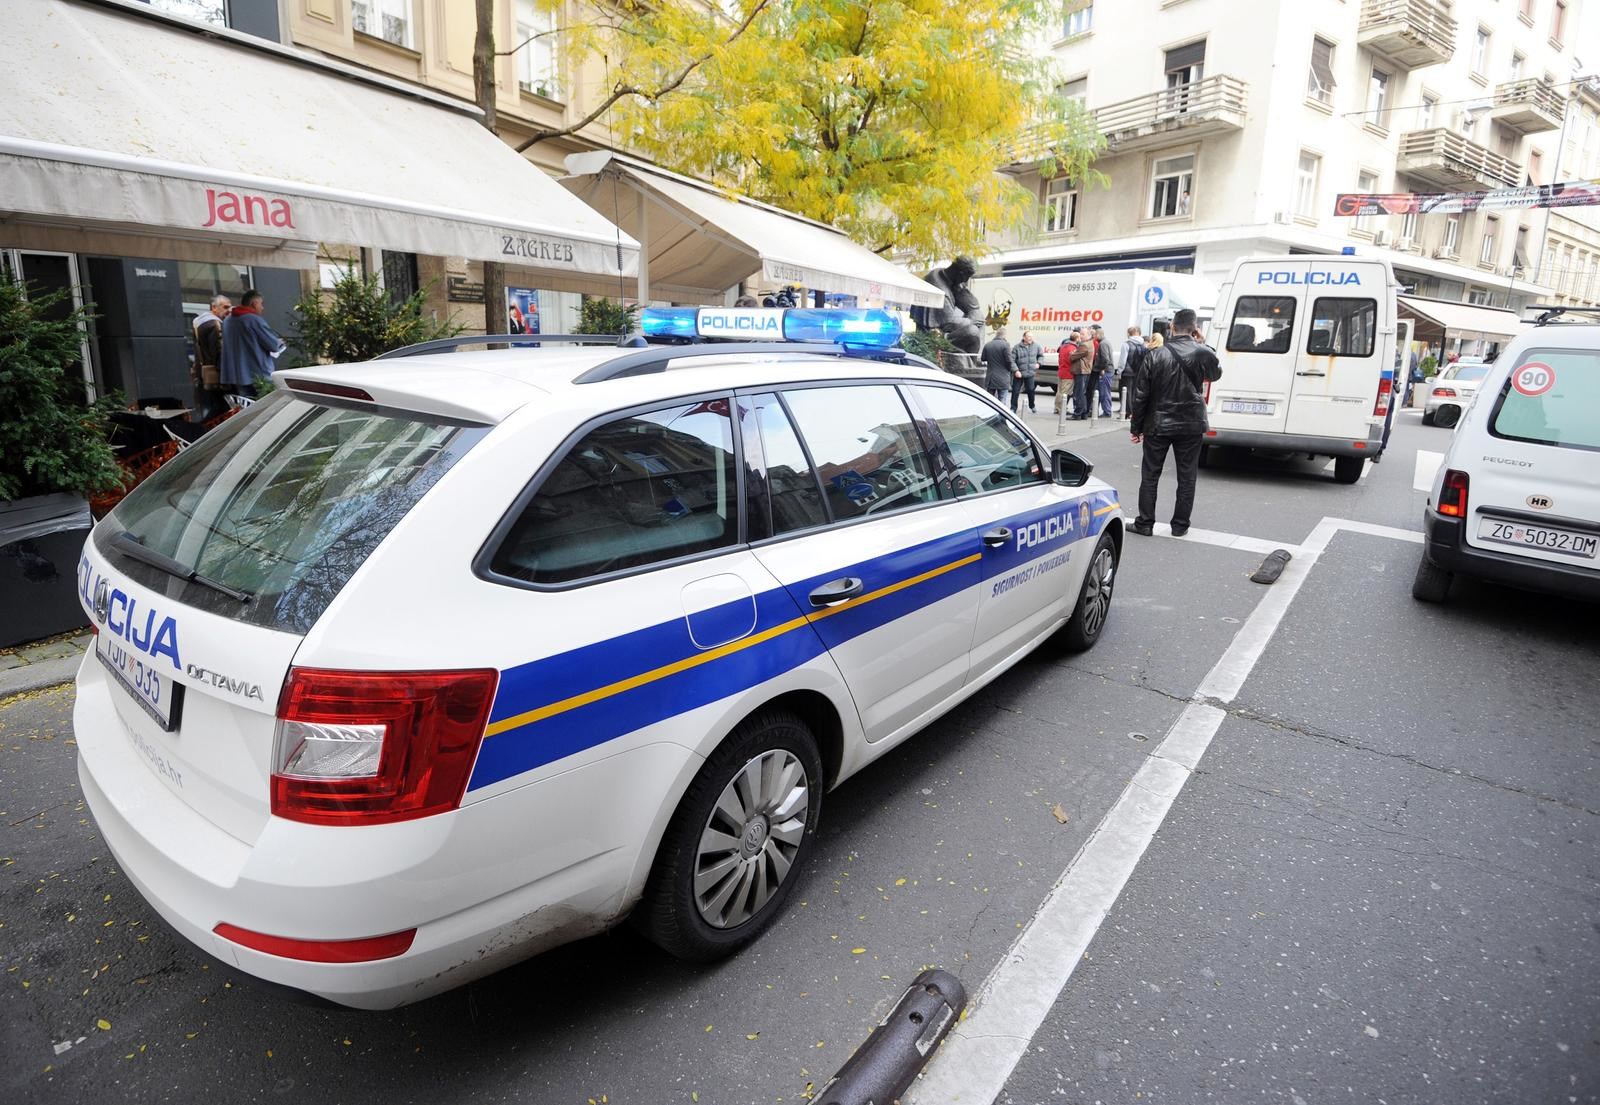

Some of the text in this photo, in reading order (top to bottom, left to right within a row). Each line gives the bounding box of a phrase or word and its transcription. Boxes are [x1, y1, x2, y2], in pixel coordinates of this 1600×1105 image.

[502, 235, 573, 262] ZAGREB
[1067, 283, 1080, 291] 099
[1096, 282, 1106, 290] 33
[1107, 281, 1117, 290] 22
[1258, 272, 1361, 286] POLICIJA
[1020, 307, 1103, 322] kalimero
[702, 316, 778, 331] POLICIJA
[1521, 372, 1547, 386] 90
[1483, 456, 1534, 468] PEUGEOT
[1531, 498, 1548, 507] HR
[1016, 512, 1074, 552] POLICIJA
[1491, 523, 1514, 539] ZG
[992, 566, 1034, 598] SIGURNOST
[79, 552, 182, 670] OLICIJA
[186, 663, 265, 702] OCTAVIA
